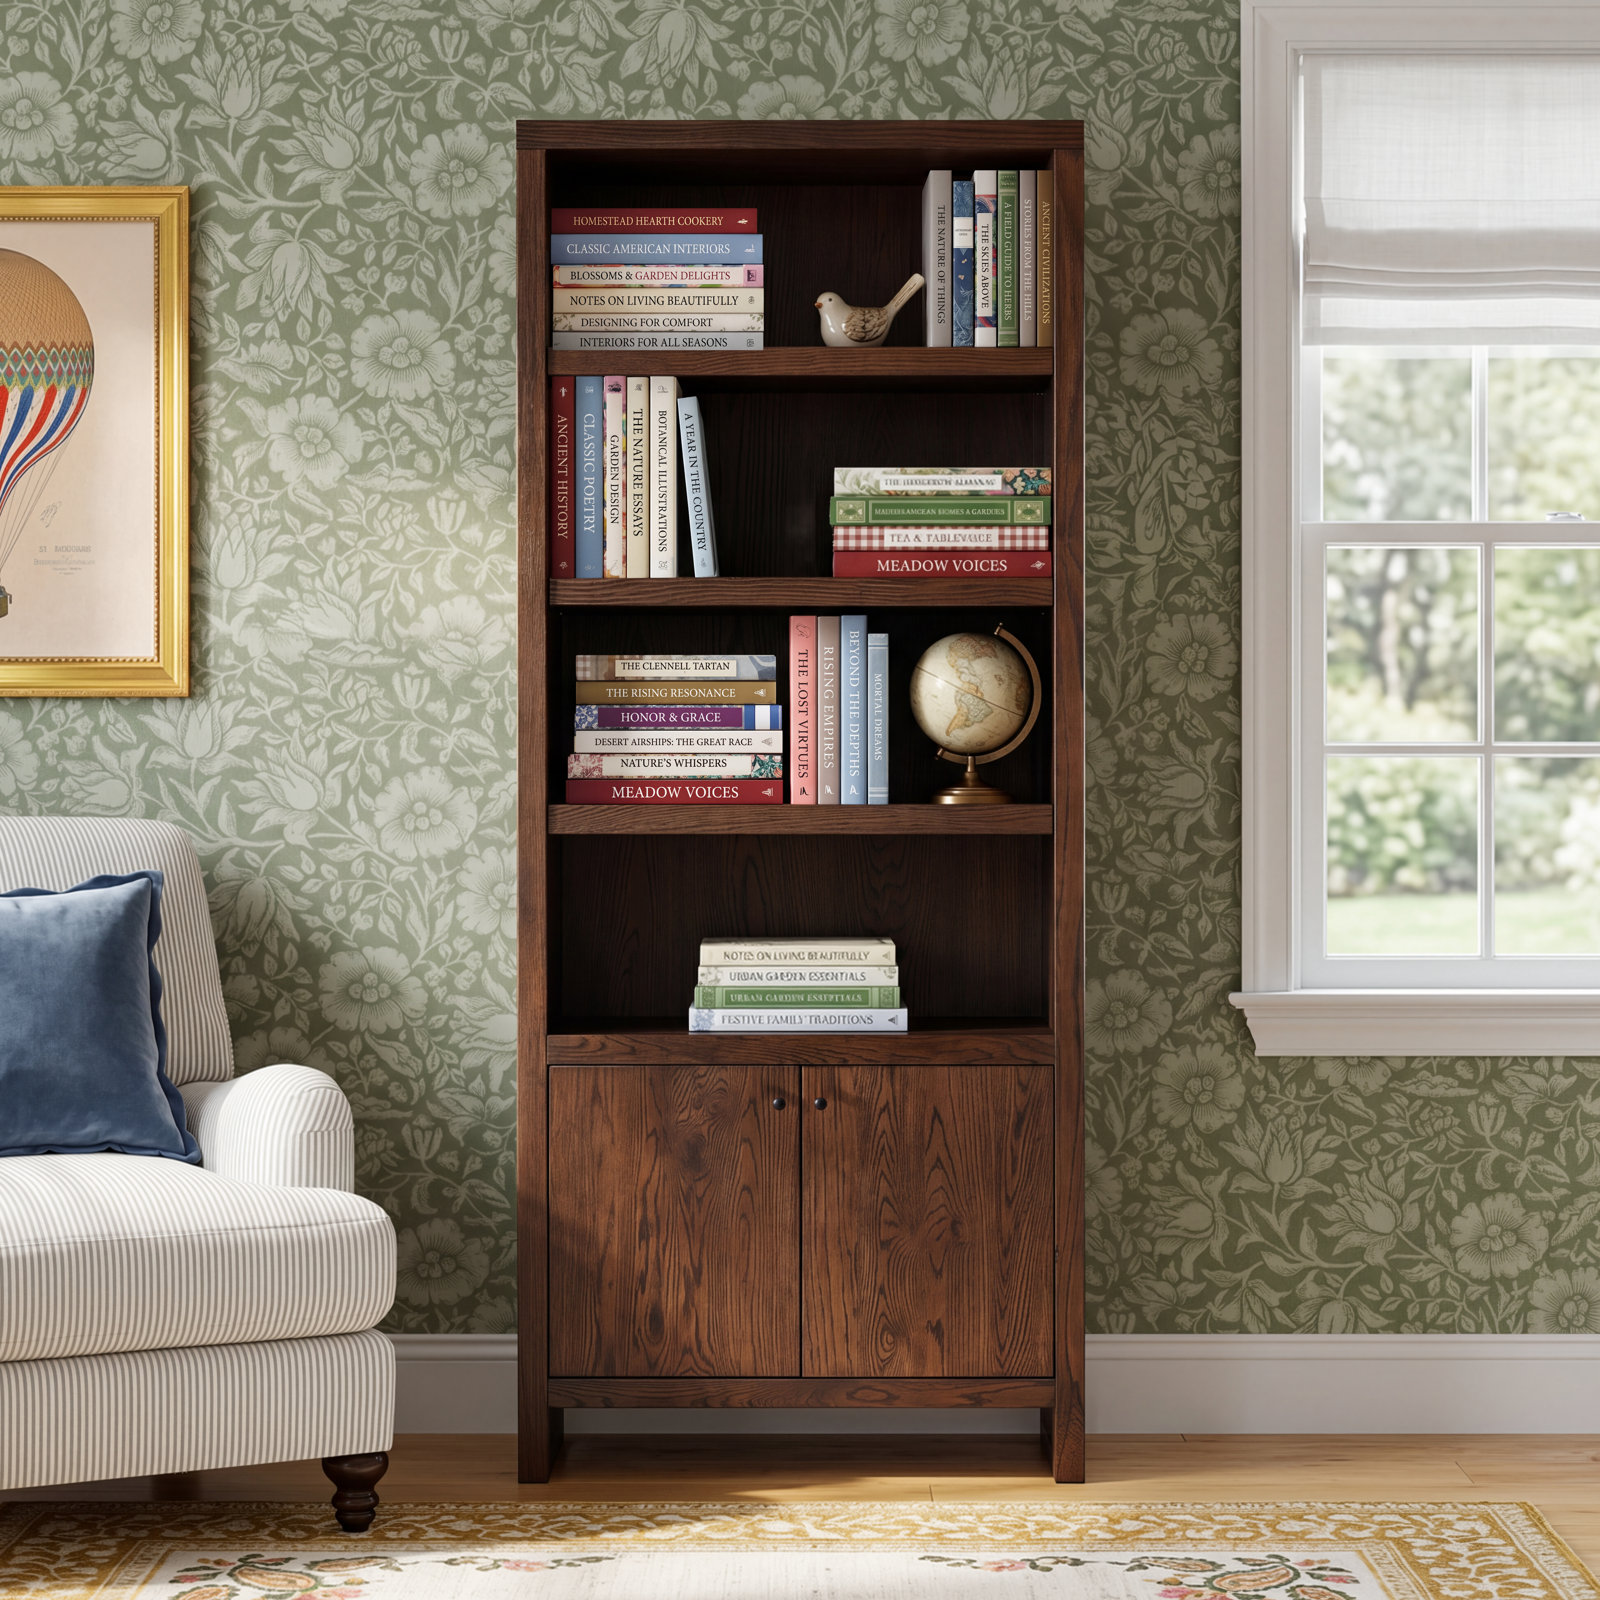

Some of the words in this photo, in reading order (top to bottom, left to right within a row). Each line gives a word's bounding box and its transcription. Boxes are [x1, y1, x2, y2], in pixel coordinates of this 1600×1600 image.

[574, 216, 634, 226] HOMESTEAD
[636, 216, 675, 226] HEARTH
[678, 216, 724, 226] COOKERY
[1004, 211, 1012, 239] FIELD
[566, 244, 610, 254] CLASSIC
[613, 244, 671, 254] AMERICAN
[674, 244, 730, 254] INTERIORS
[1004, 242, 1012, 271] GUIDE
[570, 271, 623, 281] BLOSSOMS
[625, 271, 633, 281] &
[634, 271, 678, 281] GARDEN
[680, 271, 730, 281] DELIGHTS
[938, 270, 946, 283] OF
[1004, 273, 1012, 287] TO
[570, 296, 606, 306] NOTES
[608, 296, 624, 306] ON
[627, 296, 664, 306] LIVING
[668, 296, 739, 306] BEAUTIFULLY
[1004, 290, 1012, 321] HERBS
[580, 318, 638, 328] DESIGNING
[640, 318, 660, 328] FOR
[662, 318, 713, 328] COMFORT
[580, 338, 636, 348] INTERIORS
[638, 338, 659, 348] FOR
[661, 338, 680, 348] ALL
[682, 338, 728, 348] SEASONS
[633, 408, 643, 435] THE
[684, 413, 693, 421] A
[558, 414, 568, 477] ANCIENT
[584, 414, 596, 473] CLASSIC
[658, 410, 668, 468] BOTANICAL
[686, 423, 697, 454] YEAR
[610, 434, 619, 481] GARDEN
[633, 438, 643, 490] NATURE
[688, 456, 698, 468] IN
[690, 470, 701, 494] THE
[558, 480, 568, 539] HISTORY
[584, 477, 596, 534] POETRY
[610, 484, 619, 524] DESIGN
[633, 492, 643, 537] ESSAYS
[658, 470, 668, 553] ILLUSTRATIONS
[692, 496, 707, 552] COUNTRY
[890, 534, 910, 543] TEA
[913, 534, 922, 543] &
[876, 560, 949, 572] MEADOW
[952, 560, 1008, 572] VOICES
[621, 662, 640, 670] THE
[642, 662, 690, 670] CLENNELL
[692, 662, 730, 670] TARTAN
[798, 649, 808, 678] THE
[824, 646, 834, 699] RISING
[850, 631, 860, 687] BEYOND
[606, 688, 628, 698] THE
[631, 688, 668, 698] RISING
[670, 688, 736, 698] RESONANCE
[798, 682, 808, 716] LOST
[850, 691, 860, 719] THE
[874, 674, 882, 715] MORTAL
[622, 712, 666, 722] HONOR
[669, 712, 678, 722] &
[680, 712, 721, 722] GRACE
[595, 738, 628, 746] DESERT
[630, 738, 674, 746] AIRSHIPS:
[676, 738, 694, 746] THE
[696, 738, 726, 746] GREAT
[729, 738, 752, 746] RACE
[798, 720, 808, 779] VIRTUES
[824, 706, 834, 769] EMPIRES
[850, 724, 860, 777] DEPTHS
[874, 718, 882, 761] DREAMS
[620, 758, 672, 768] NATURE'S
[674, 758, 727, 768] WHISPERS
[612, 786, 682, 798] MEADOW
[685, 786, 739, 798] VOICES
